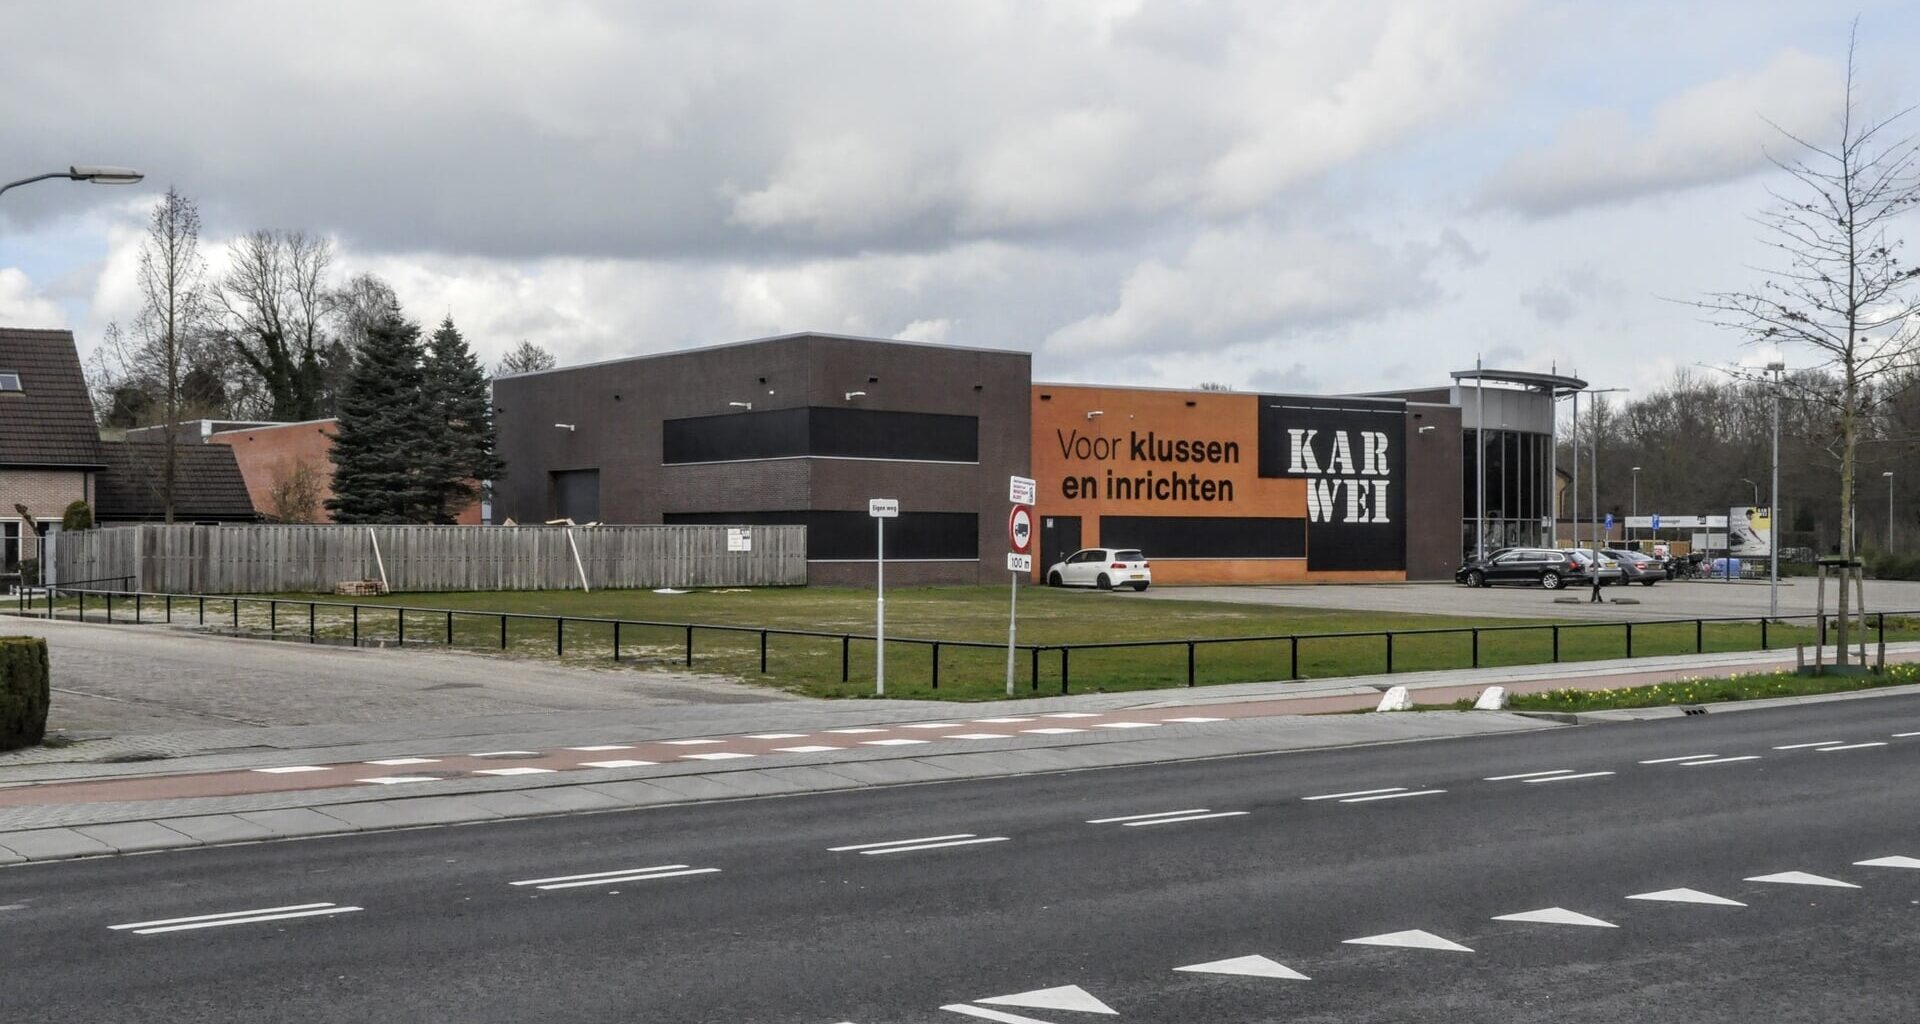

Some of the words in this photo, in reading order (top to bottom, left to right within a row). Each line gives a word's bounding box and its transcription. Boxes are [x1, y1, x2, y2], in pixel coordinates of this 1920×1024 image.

[1057, 429, 1123, 461] Voor
[1131, 431, 1239, 464] klussen
[1287, 428, 1390, 476] KAR
[1062, 476, 1098, 500] en
[1106, 470, 1234, 502] inrichten
[1307, 479, 1390, 523] WEI
[872, 505, 886, 513] Eigen
[1012, 557, 1022, 568] 100
[1024, 560, 1030, 569] m
